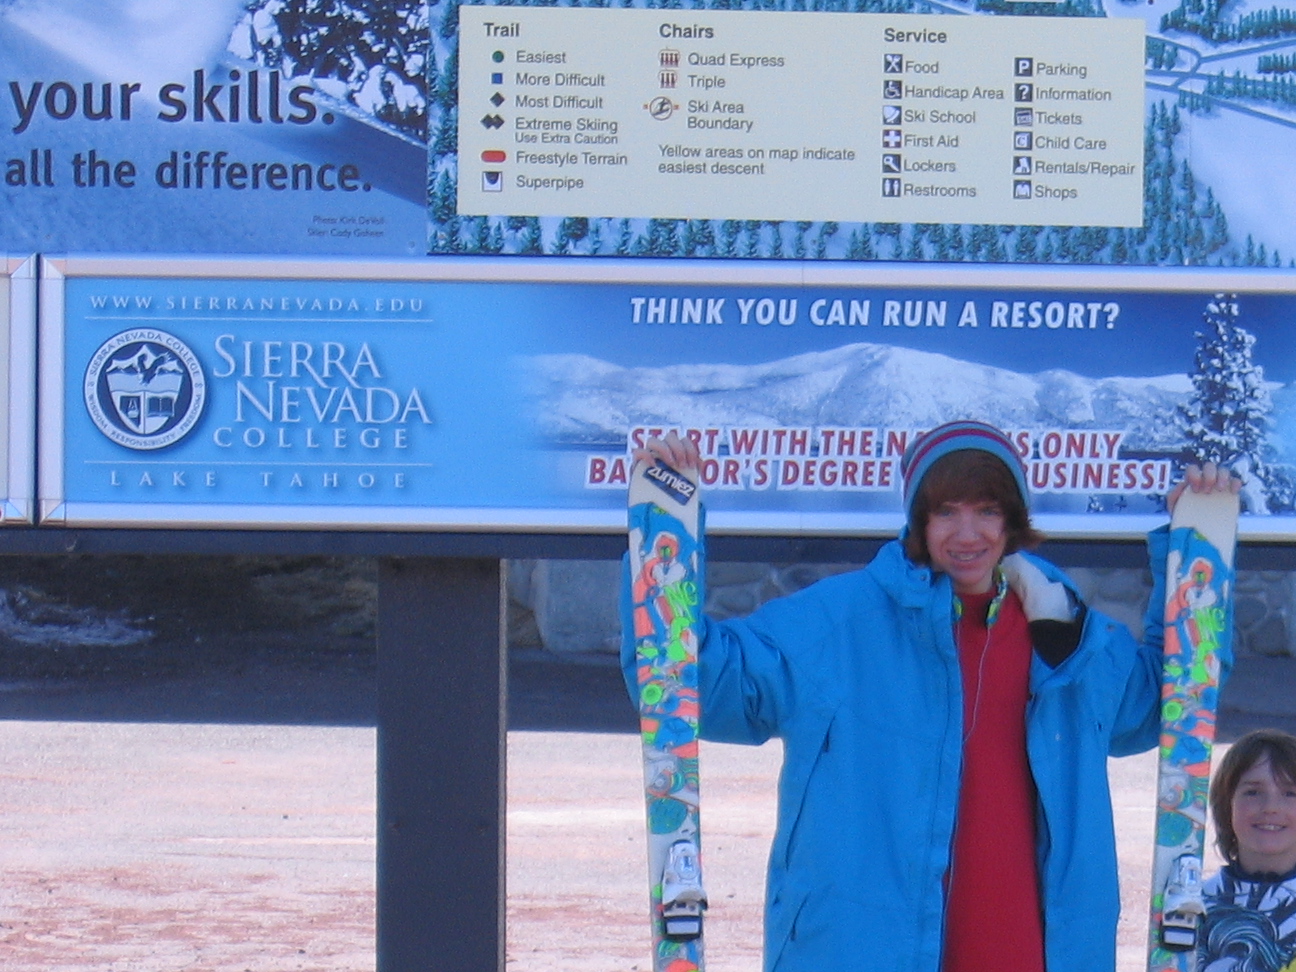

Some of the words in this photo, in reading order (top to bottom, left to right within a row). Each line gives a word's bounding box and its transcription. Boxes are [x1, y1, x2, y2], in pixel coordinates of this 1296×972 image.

[483, 22, 520, 37] Trail
[659, 23, 714, 38] Chairs
[884, 28, 947, 43] Service
[516, 50, 567, 63] Easiest
[688, 53, 726, 66] Quad
[730, 53, 785, 69] Express
[905, 60, 939, 74] Food
[1036, 62, 1087, 79] Parking
[516, 73, 550, 85] More
[555, 73, 605, 86] Difficult
[688, 75, 726, 90] Triple
[904, 85, 969, 101] Handicap
[972, 87, 1004, 99] Area
[1036, 87, 1112, 101] Information
[8, 80, 142, 134] your
[158, 69, 335, 125] skills.
[515, 95, 549, 108] Most
[553, 96, 603, 109] Difficult
[688, 100, 709, 113] Ski
[712, 101, 744, 114] Area
[904, 110, 925, 122] Ski
[929, 110, 976, 123] School
[1035, 111, 1082, 125] Tickets
[515, 117, 572, 130] Extreme
[576, 117, 618, 134] Skiing
[688, 117, 753, 133] Boundary
[515, 133, 538, 143] Use
[541, 133, 571, 144] Extra
[574, 133, 618, 144] Caution
[904, 135, 934, 147] First
[936, 135, 959, 147] Aid
[1035, 136, 1070, 149] Child
[1074, 136, 1107, 150] Care
[516, 151, 578, 167] Freestyle
[582, 152, 628, 165] Terrain
[659, 144, 700, 158] Yellow
[705, 148, 743, 158] areas
[748, 149, 764, 158] on
[769, 149, 798, 162] map
[802, 147, 855, 160] indicate
[5, 149, 55, 188] all
[72, 150, 137, 188] the
[155, 151, 372, 192] difference.
[658, 161, 707, 174] easiest
[711, 161, 765, 175] descent
[904, 159, 956, 172] Lockers
[1035, 161, 1135, 177] Rentals/Repair
[516, 175, 584, 190] Superpipe
[903, 183, 977, 197] Restrooms
[1035, 185, 1078, 201] Shops
[90, 296, 423, 312] WWW.SIERRANEVADA.EDU
[630, 298, 726, 324] THINK
[736, 298, 798, 326] YOU
[809, 299, 870, 326] CAN
[882, 300, 947, 327] RUN
[957, 301, 978, 328] A
[990, 301, 1120, 330] RESORT?
[213, 334, 382, 388] SIERRA
[235, 380, 433, 424] NEVADA
[213, 427, 409, 449] COLLEGE
[730, 428, 806, 456] WITH
[820, 430, 874, 456] THE
[1043, 432, 1122, 459] ONLY
[589, 457, 770, 485] BAOR'S
[781, 459, 893, 487] DEGREE
[110, 471, 217, 487] LAKE
[260, 472, 406, 489] TAHOE
